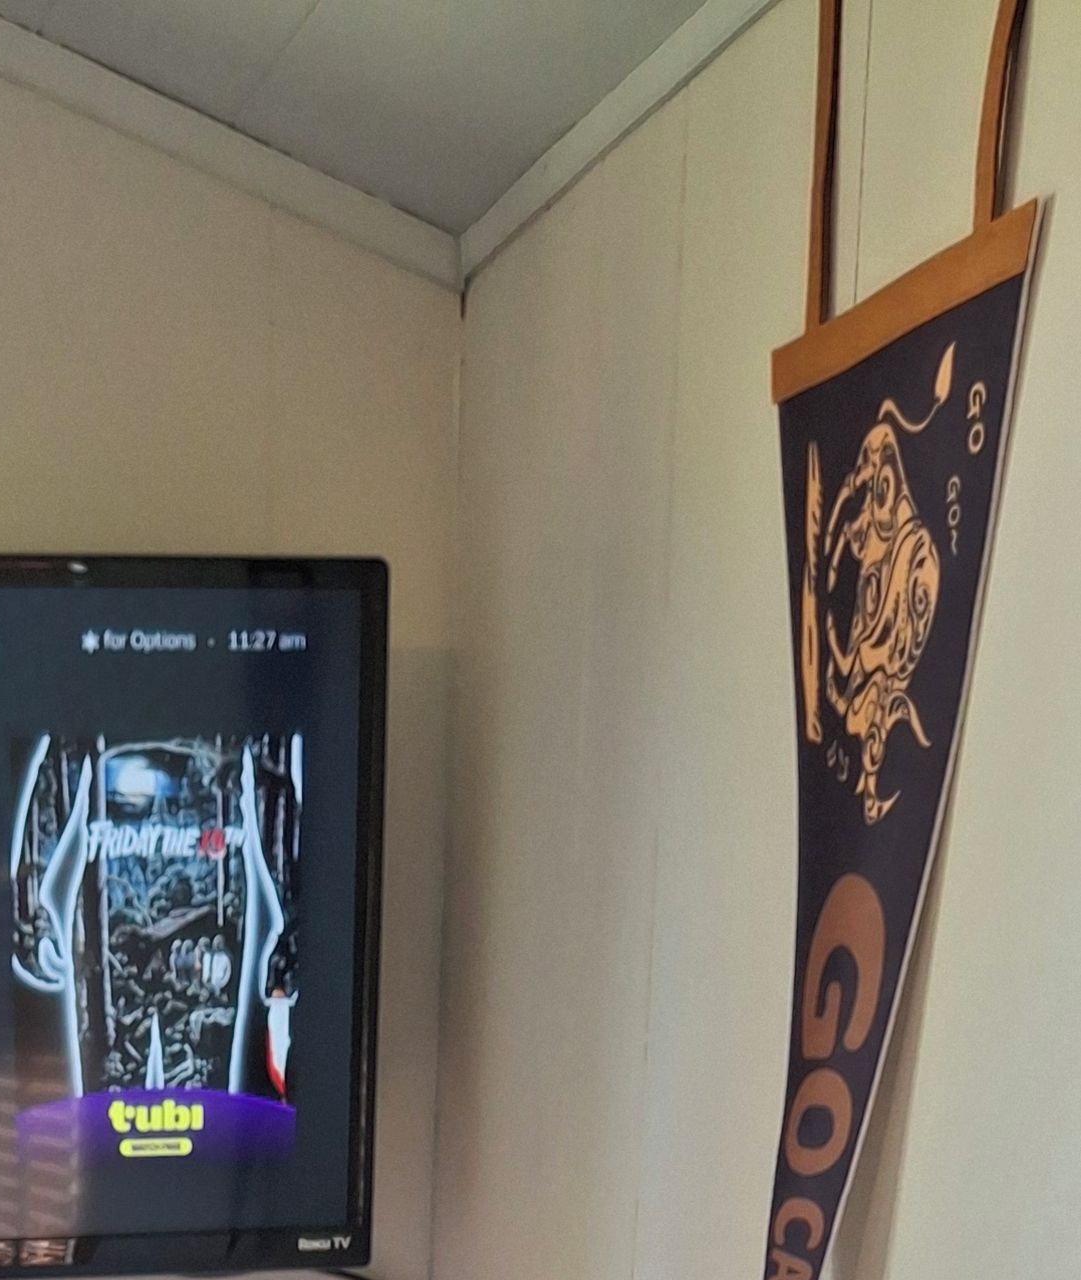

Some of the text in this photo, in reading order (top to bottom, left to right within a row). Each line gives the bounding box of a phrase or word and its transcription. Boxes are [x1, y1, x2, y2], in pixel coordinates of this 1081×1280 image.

[966, 381, 987, 455] GO
[103, 628, 197, 654] for Options
[229, 629, 307, 652] 11:27 am
[784, 871, 887, 1177] GO
[108, 1099, 204, 1133] tubi
[298, 1235, 352, 1251] Roku TV
